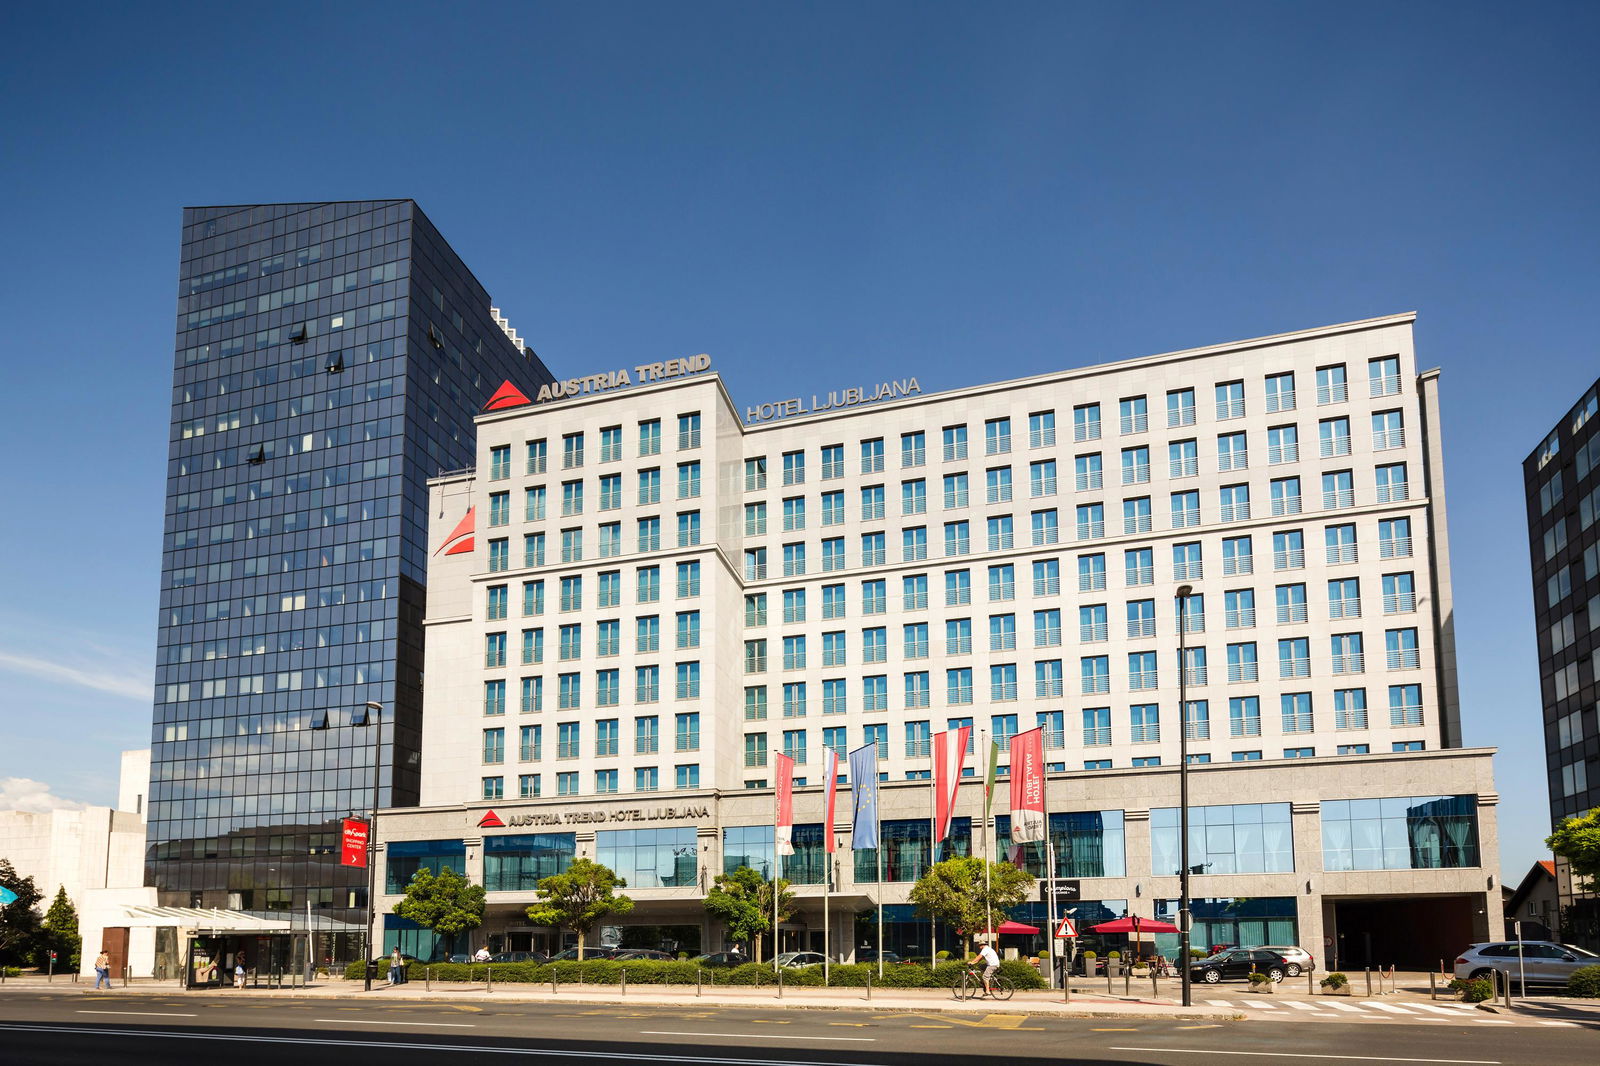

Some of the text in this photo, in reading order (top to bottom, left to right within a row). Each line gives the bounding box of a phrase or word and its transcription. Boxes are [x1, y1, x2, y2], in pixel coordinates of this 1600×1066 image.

[536, 353, 712, 403] AUSTRIA TREND
[747, 377, 922, 422] HOTEL LJUBLJANA
[508, 805, 710, 827] AUSTRIA TREND HOTEL LJUBLJANA
